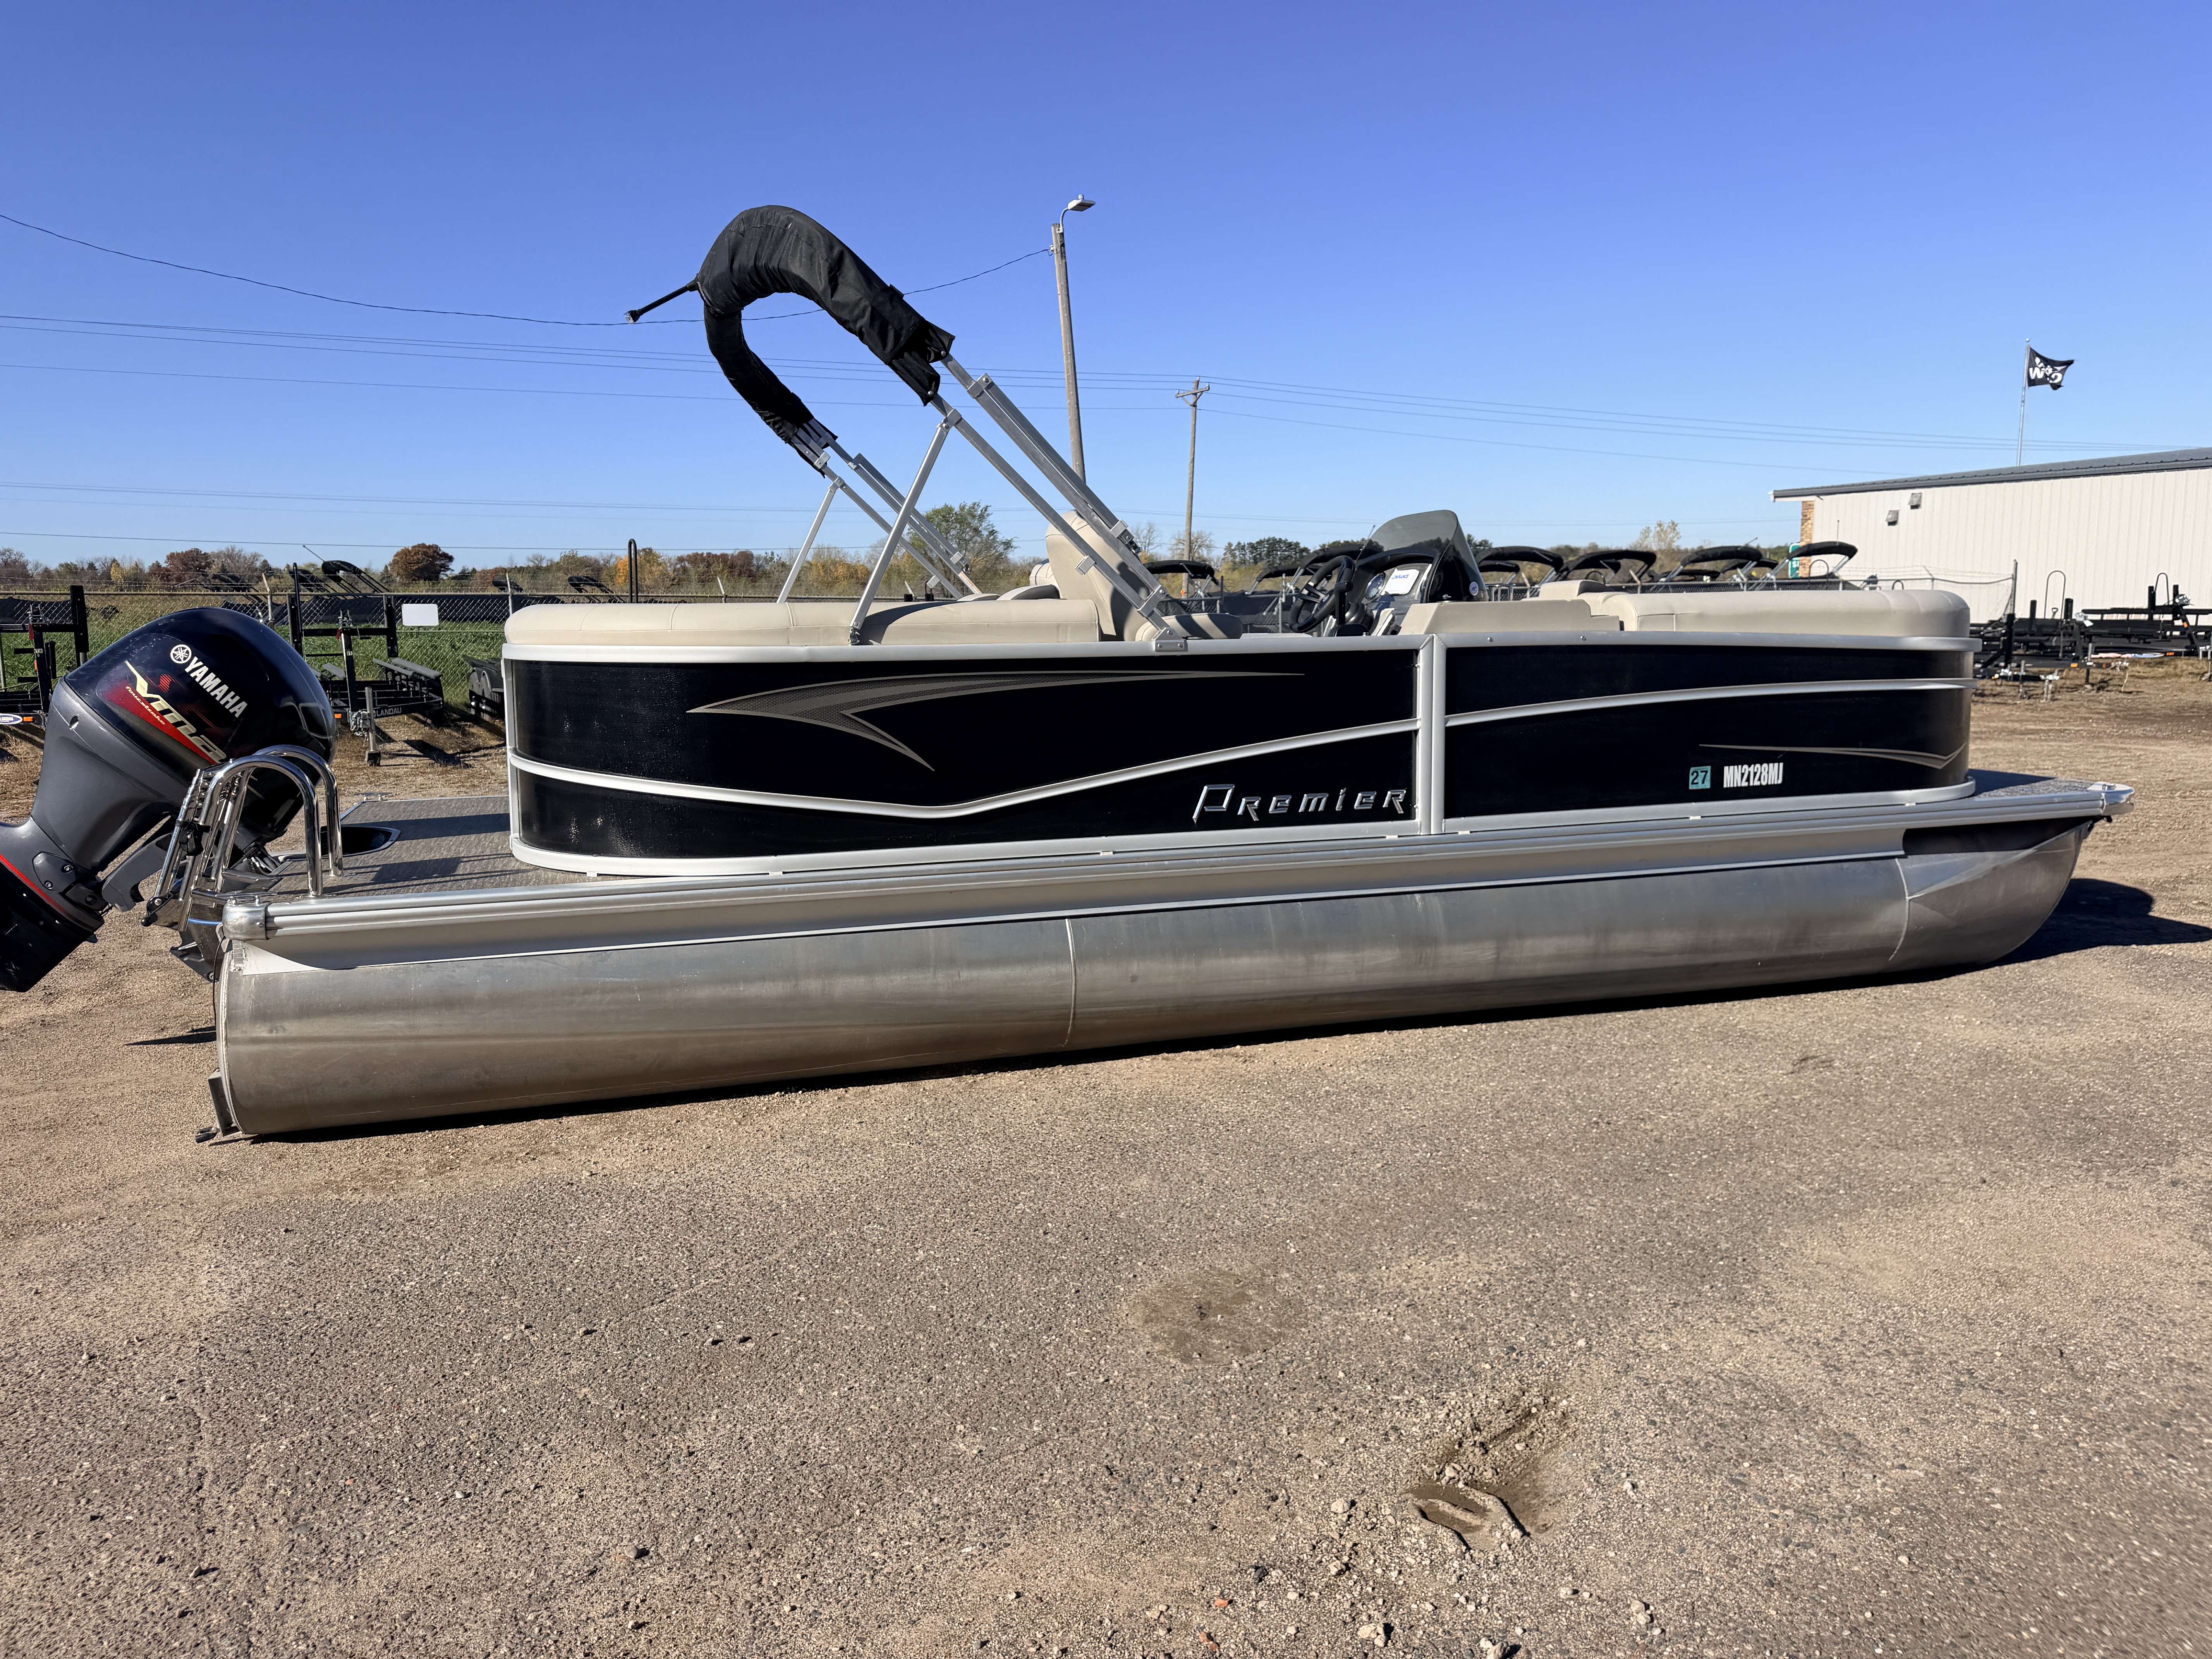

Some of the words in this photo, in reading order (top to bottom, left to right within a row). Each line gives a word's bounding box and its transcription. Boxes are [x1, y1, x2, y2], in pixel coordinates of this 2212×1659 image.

[185, 656, 248, 718] YAMAHA
[376, 707, 402, 717] LANDAU
[1691, 770, 1708, 785] 27
[1723, 762, 1783, 788] MN2128MJ
